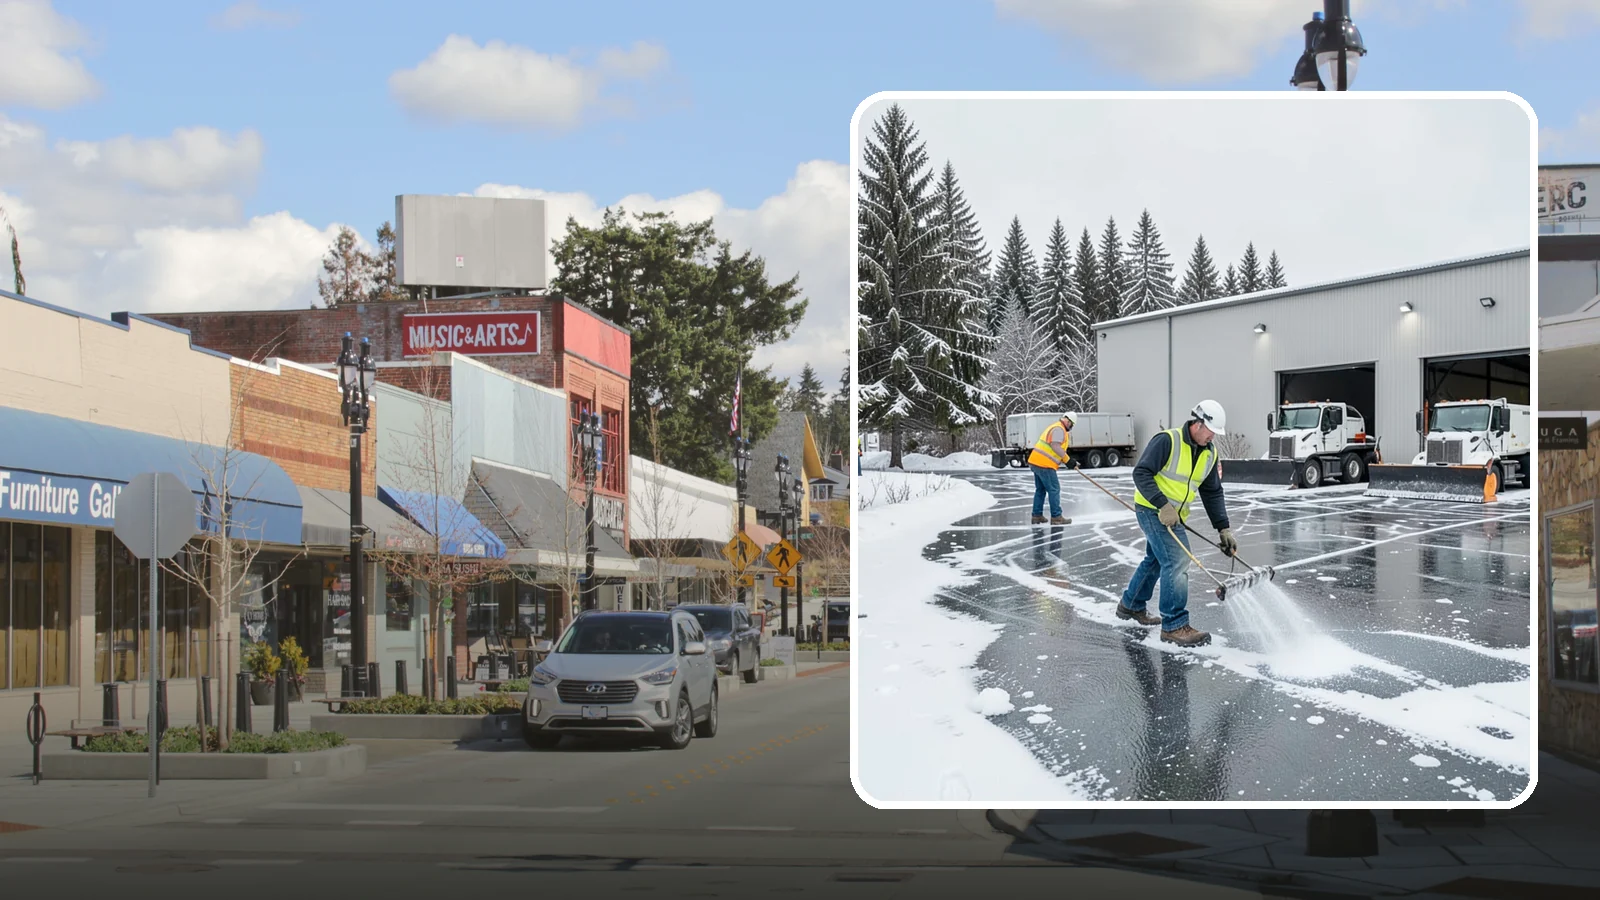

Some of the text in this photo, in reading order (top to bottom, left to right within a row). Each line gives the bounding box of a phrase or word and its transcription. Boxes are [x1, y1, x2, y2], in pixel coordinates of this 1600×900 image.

[0, 471, 122, 519] Furniture Gal
[453, 563, 479, 575] SUSHI
